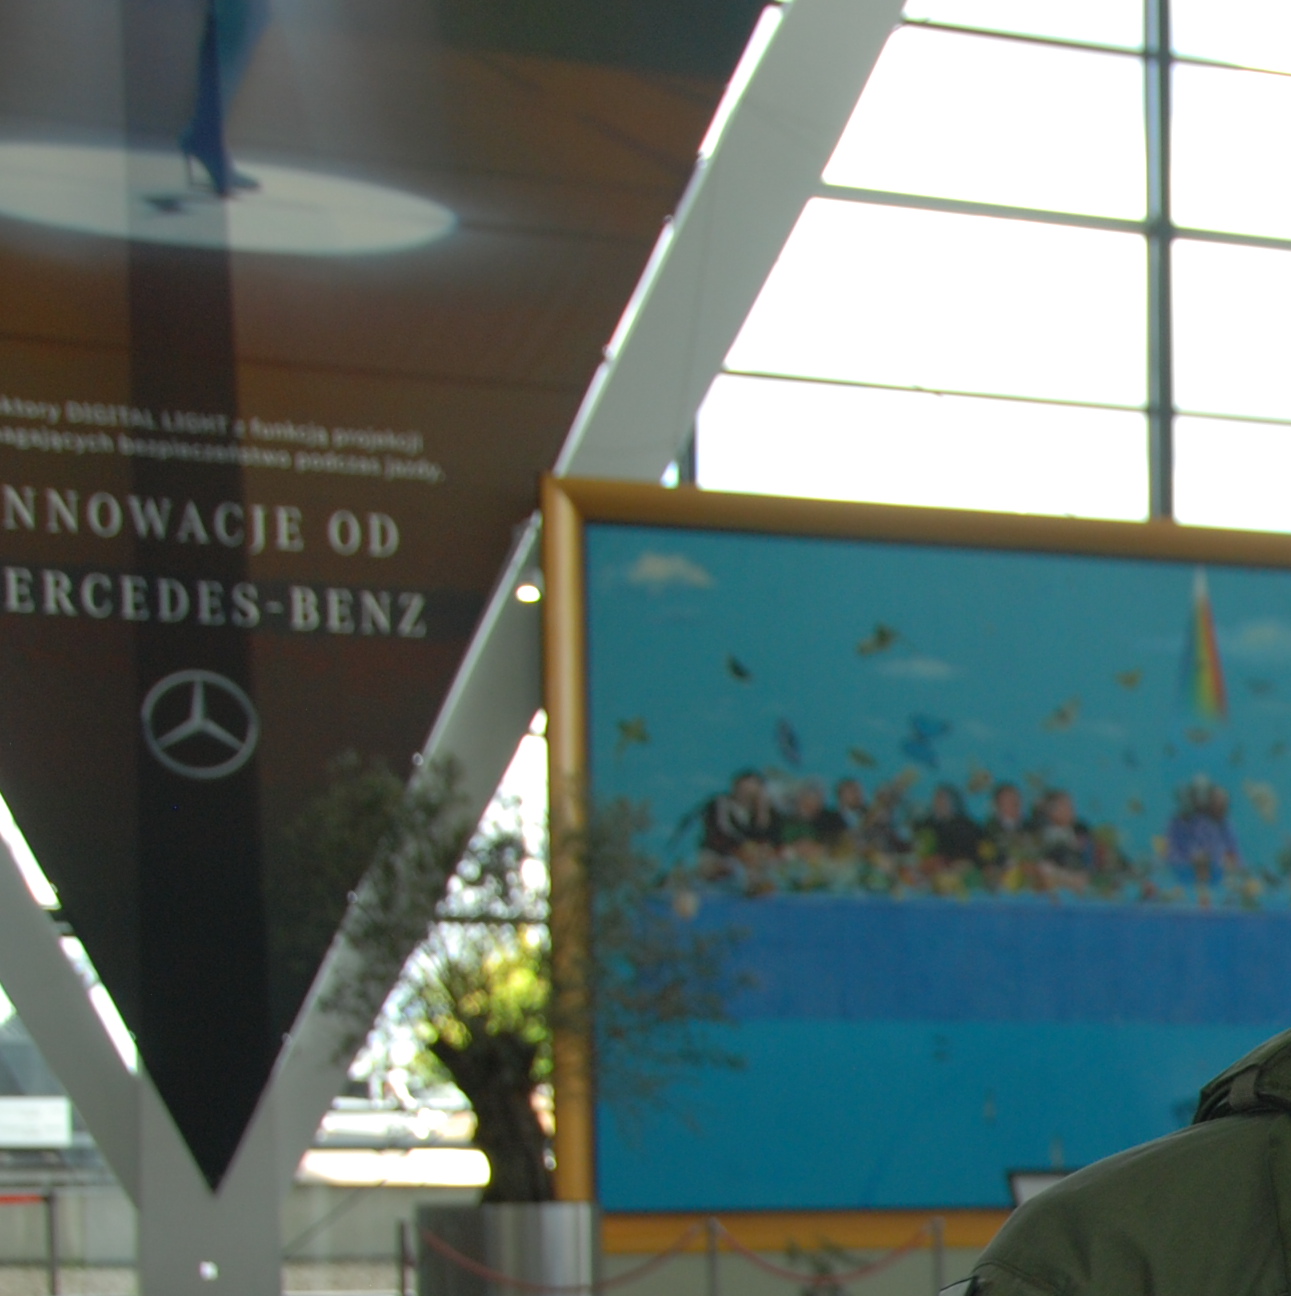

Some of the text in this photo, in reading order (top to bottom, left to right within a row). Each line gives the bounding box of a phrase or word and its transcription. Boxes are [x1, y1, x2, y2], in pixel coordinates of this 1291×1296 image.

[65, 399, 158, 431] DIGITAL
[161, 408, 229, 436] LIGHT
[294, 450, 382, 477] podczas
[3, 483, 401, 558] NNOWACJE OD
[4, 566, 428, 638] ERCEDES-BENZ
